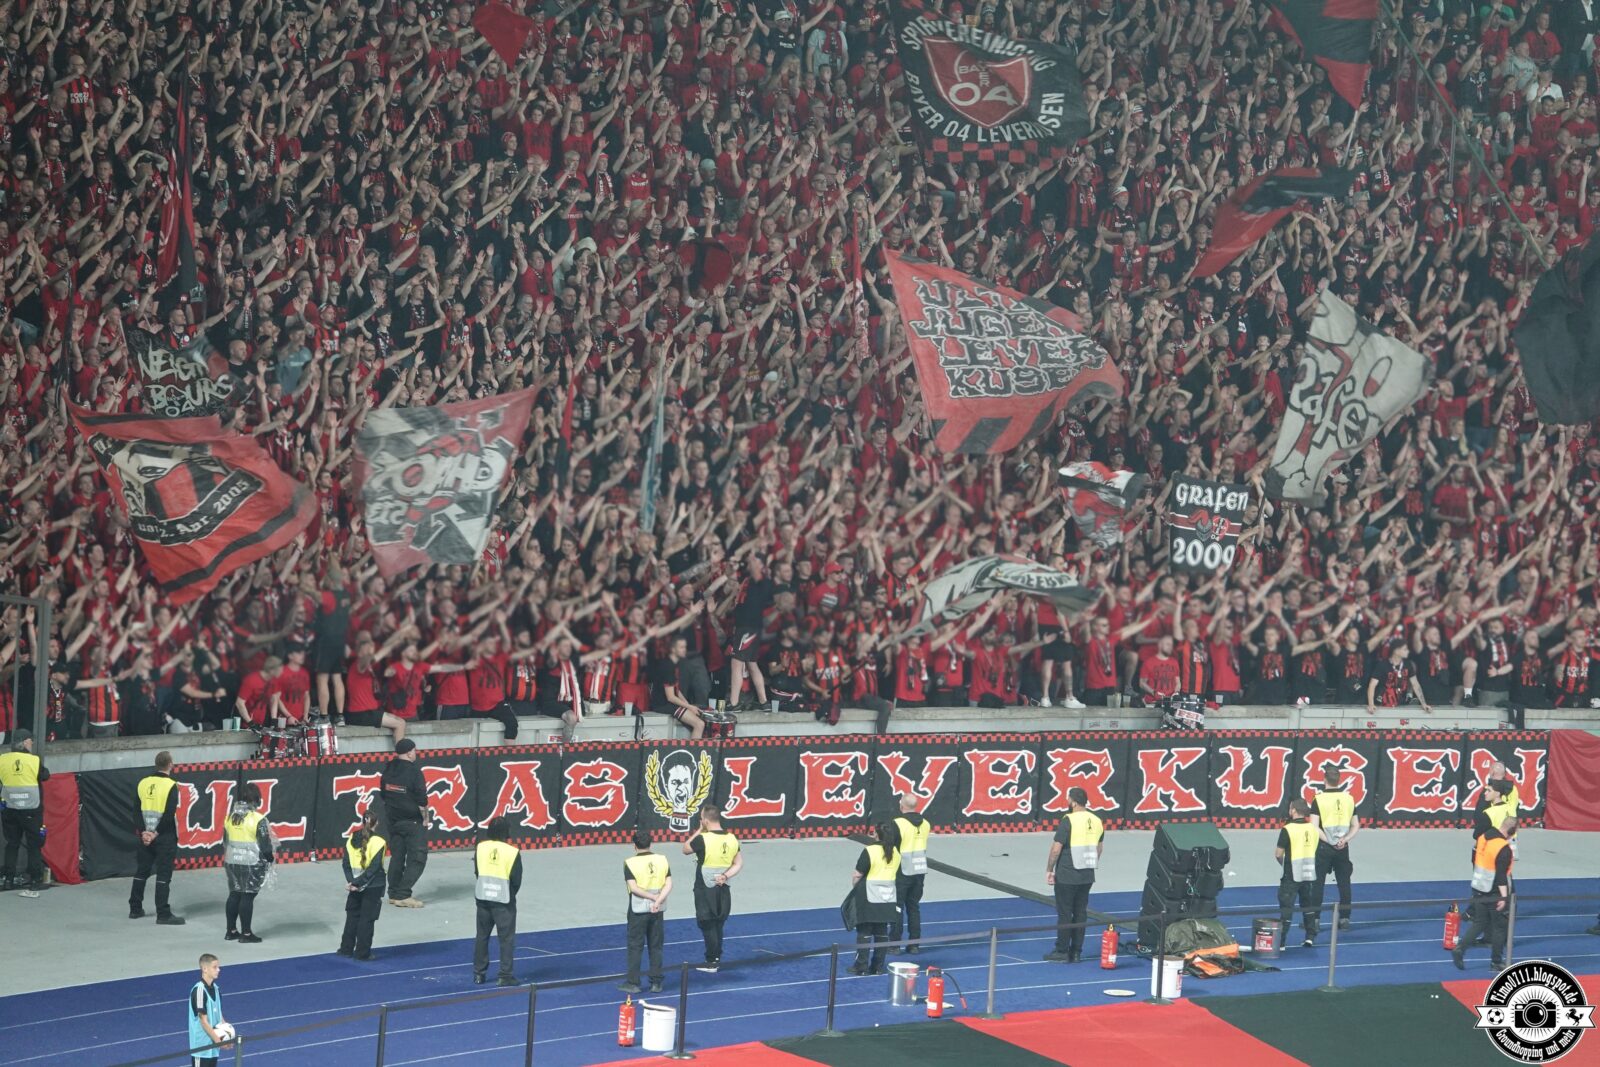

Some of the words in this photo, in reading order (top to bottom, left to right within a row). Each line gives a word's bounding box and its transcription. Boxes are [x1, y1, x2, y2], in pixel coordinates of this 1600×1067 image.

[905, 70, 944, 129] BAYER
[943, 120, 970, 142] 04
[212, 480, 250, 514] 2005
[1172, 537, 1236, 570] 2009
[174, 757, 630, 850] ULTRAS
[720, 745, 1547, 820] LEVERKUSEN
[673, 817, 686, 826] UL
